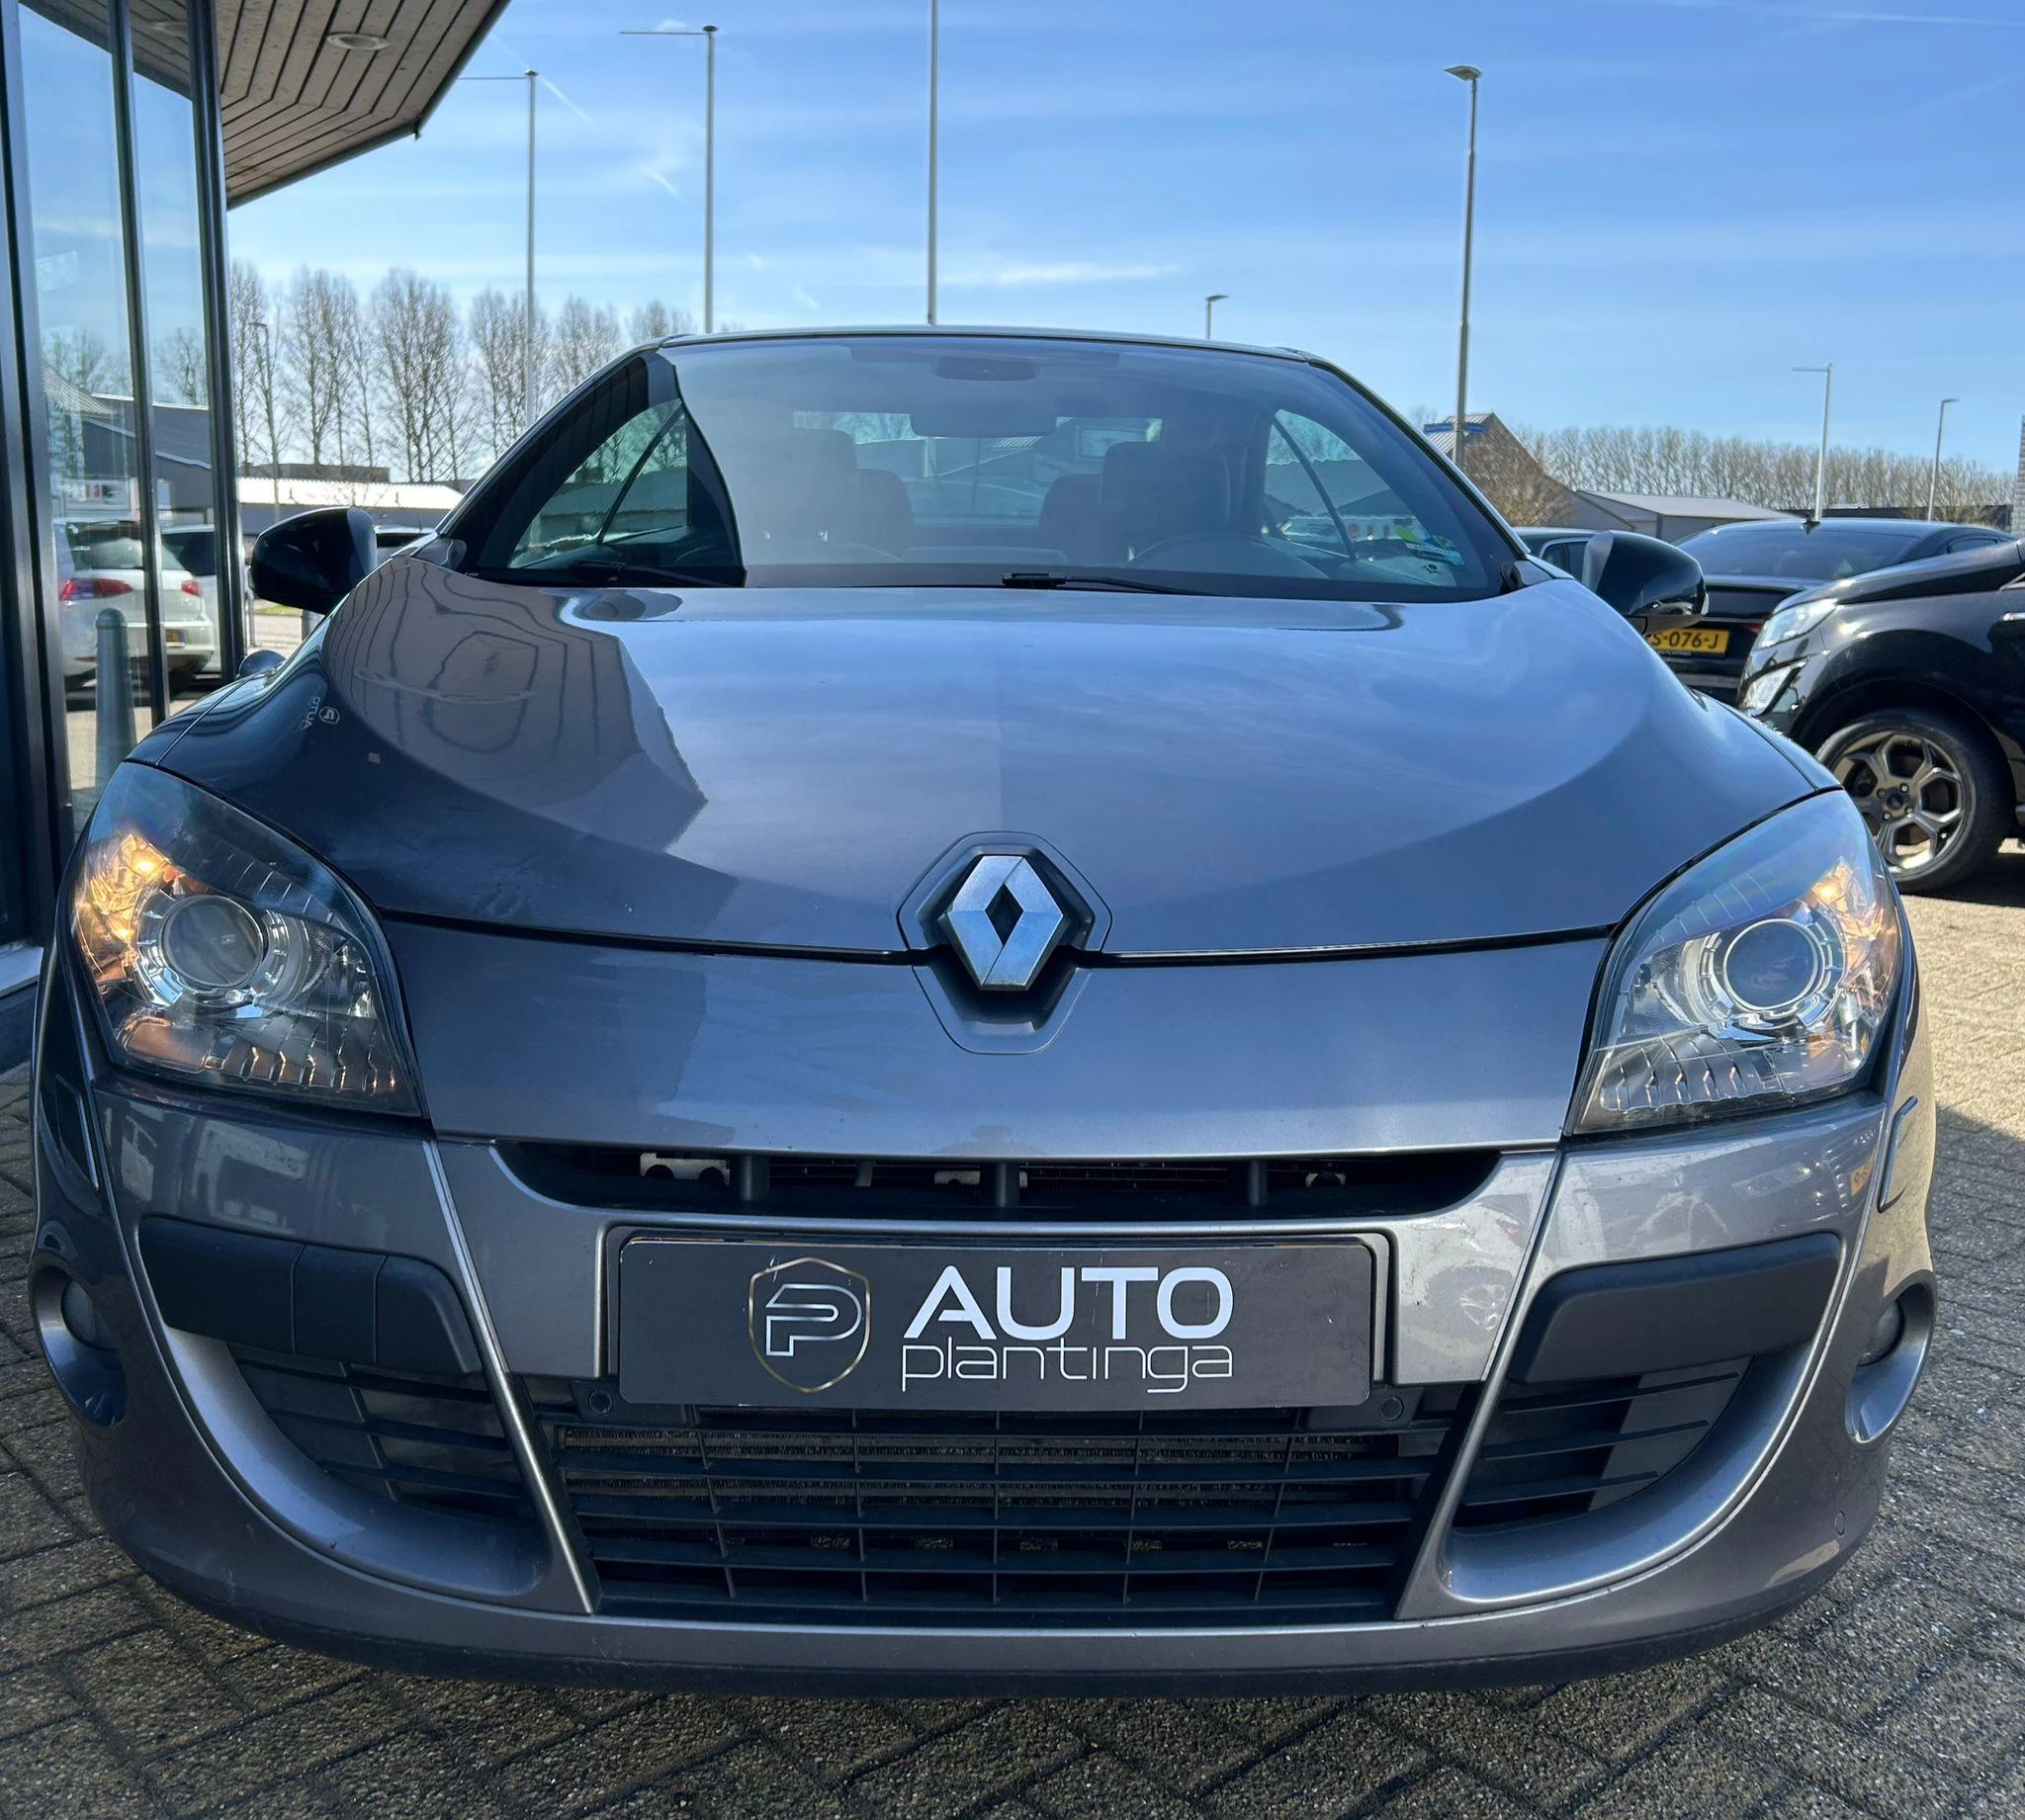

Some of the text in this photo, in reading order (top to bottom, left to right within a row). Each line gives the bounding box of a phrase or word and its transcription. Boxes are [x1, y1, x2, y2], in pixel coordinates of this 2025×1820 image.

[1647, 631, 1718, 649] S-076-J
[903, 1264, 1234, 1341] AUTO
[902, 1336, 1233, 1394] plantinga
